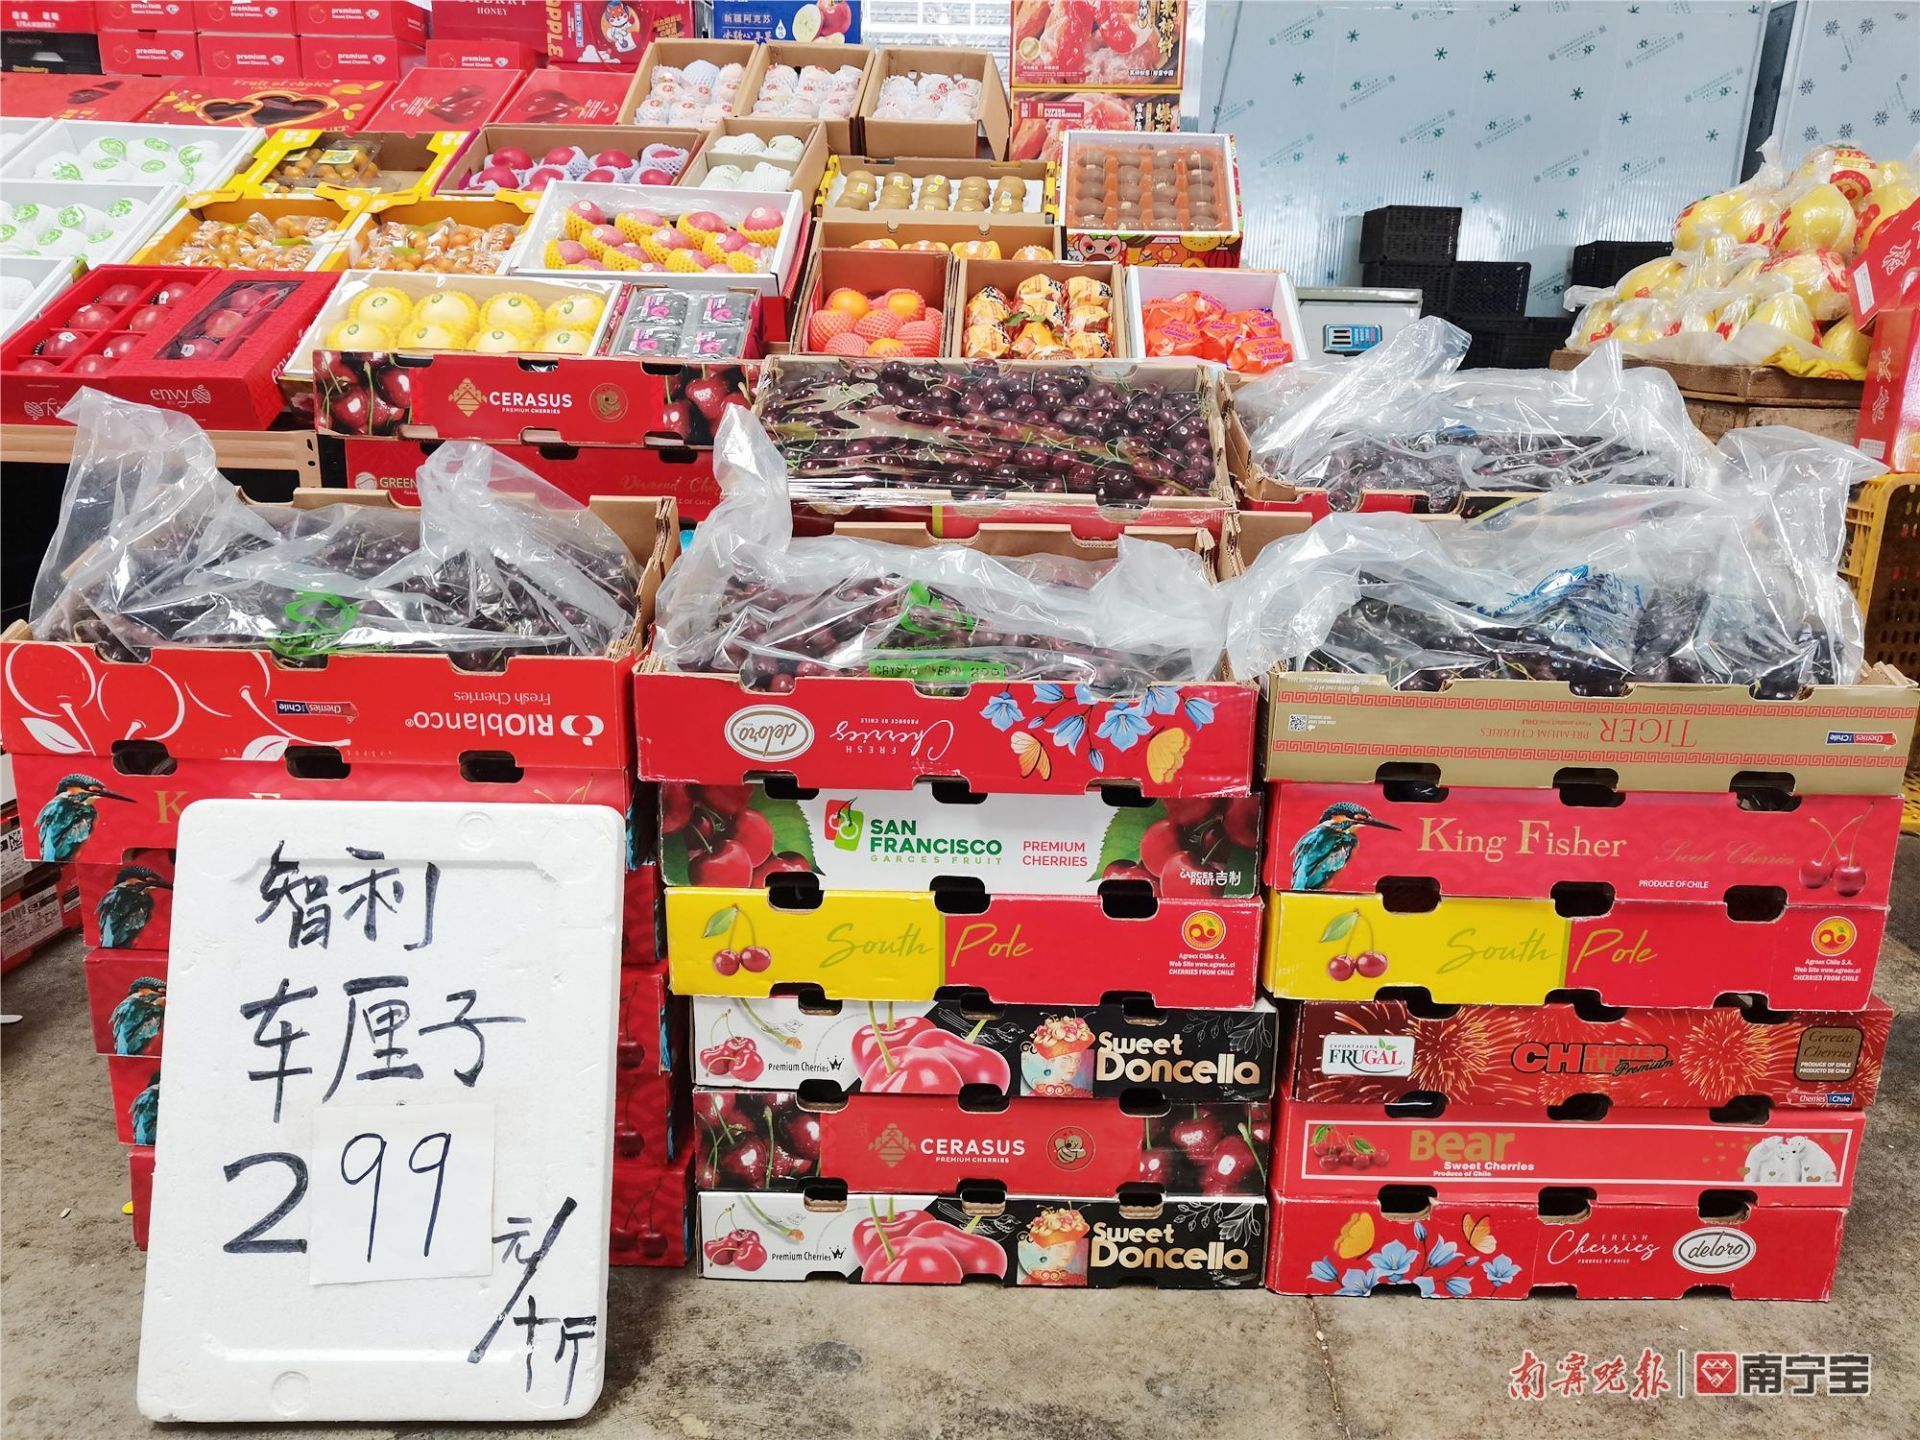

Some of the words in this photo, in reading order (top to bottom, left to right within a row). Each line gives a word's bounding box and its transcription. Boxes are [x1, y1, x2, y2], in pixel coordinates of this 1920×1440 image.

[477, 7, 507, 16] HONEY
[723, 13, 772, 24] 新疆阿克苏
[136, 48, 166, 56] premium
[461, 55, 491, 63] premium
[289, 80, 332, 88] choice
[150, 387, 195, 408] envy
[489, 391, 573, 408] CERASUS
[502, 407, 530, 415] PREMIUM
[454, 690, 511, 705] Cherries
[516, 692, 551, 705] Fresh
[279, 703, 302, 712] Chile
[309, 703, 342, 713] Cherries
[1480, 727, 1535, 738] CHERRIES
[1537, 729, 1589, 740] PREMIUM
[1599, 717, 1698, 748] TIGER
[1829, 733, 1850, 742] Chile
[1855, 734, 1884, 743] Cherries
[739, 722, 798, 757] deloro
[829, 719, 954, 761] Cherries
[870, 819, 917, 836] SAN
[870, 836, 1003, 856] FRANCISCO
[1416, 816, 1506, 863] King
[1515, 819, 1628, 858] Fisher
[1022, 840, 1086, 853] PREMIUM
[1655, 838, 1714, 863] Sweet
[1723, 837, 1796, 866] Cherries
[870, 855, 941, 864] GARCES
[951, 856, 1002, 865] FRUIT
[1022, 855, 1088, 867] CHERRIES
[1190, 878, 1215, 886] FRUIT
[1639, 879, 1675, 888] PRODUCE
[1676, 880, 1686, 888] OF
[1687, 880, 1709, 889] CHILE
[254, 840, 440, 951] 智利
[819, 922, 935, 969] South
[950, 922, 1034, 968] Pole
[1435, 927, 1559, 975] South
[1572, 928, 1659, 974] Pole
[1098, 1031, 1183, 1055] Sweet
[1809, 1030, 1856, 1043] Cerezas
[239, 974, 527, 1123] 车厘子
[1803, 1045, 1852, 1058] Cherries
[1328, 1049, 1403, 1066] FRUGAL
[768, 1062, 800, 1074] Premium
[801, 1061, 829, 1074] Cherries
[1097, 1053, 1260, 1085] Doncella
[1612, 1059, 1674, 1077] Premium
[1799, 1095, 1826, 1103] Cherries
[1831, 1095, 1851, 1103] Chile
[920, 1137, 1025, 1156] CERASUS
[1409, 1128, 1516, 1162] Bear
[935, 1156, 972, 1164] PREMIUM
[972, 1156, 1010, 1164] CHERRIES
[1443, 1161, 1481, 1171] Sweet
[1484, 1161, 1535, 1171] Cherries
[1093, 1221, 1176, 1245] Sweet
[1601, 1234, 1648, 1242] FRESH
[1547, 1229, 1661, 1265] Cherries
[1687, 1230, 1744, 1259] deloro
[771, 1252, 803, 1263] Premium
[804, 1251, 832, 1263] Cherries
[1091, 1241, 1249, 1270] Doncella
